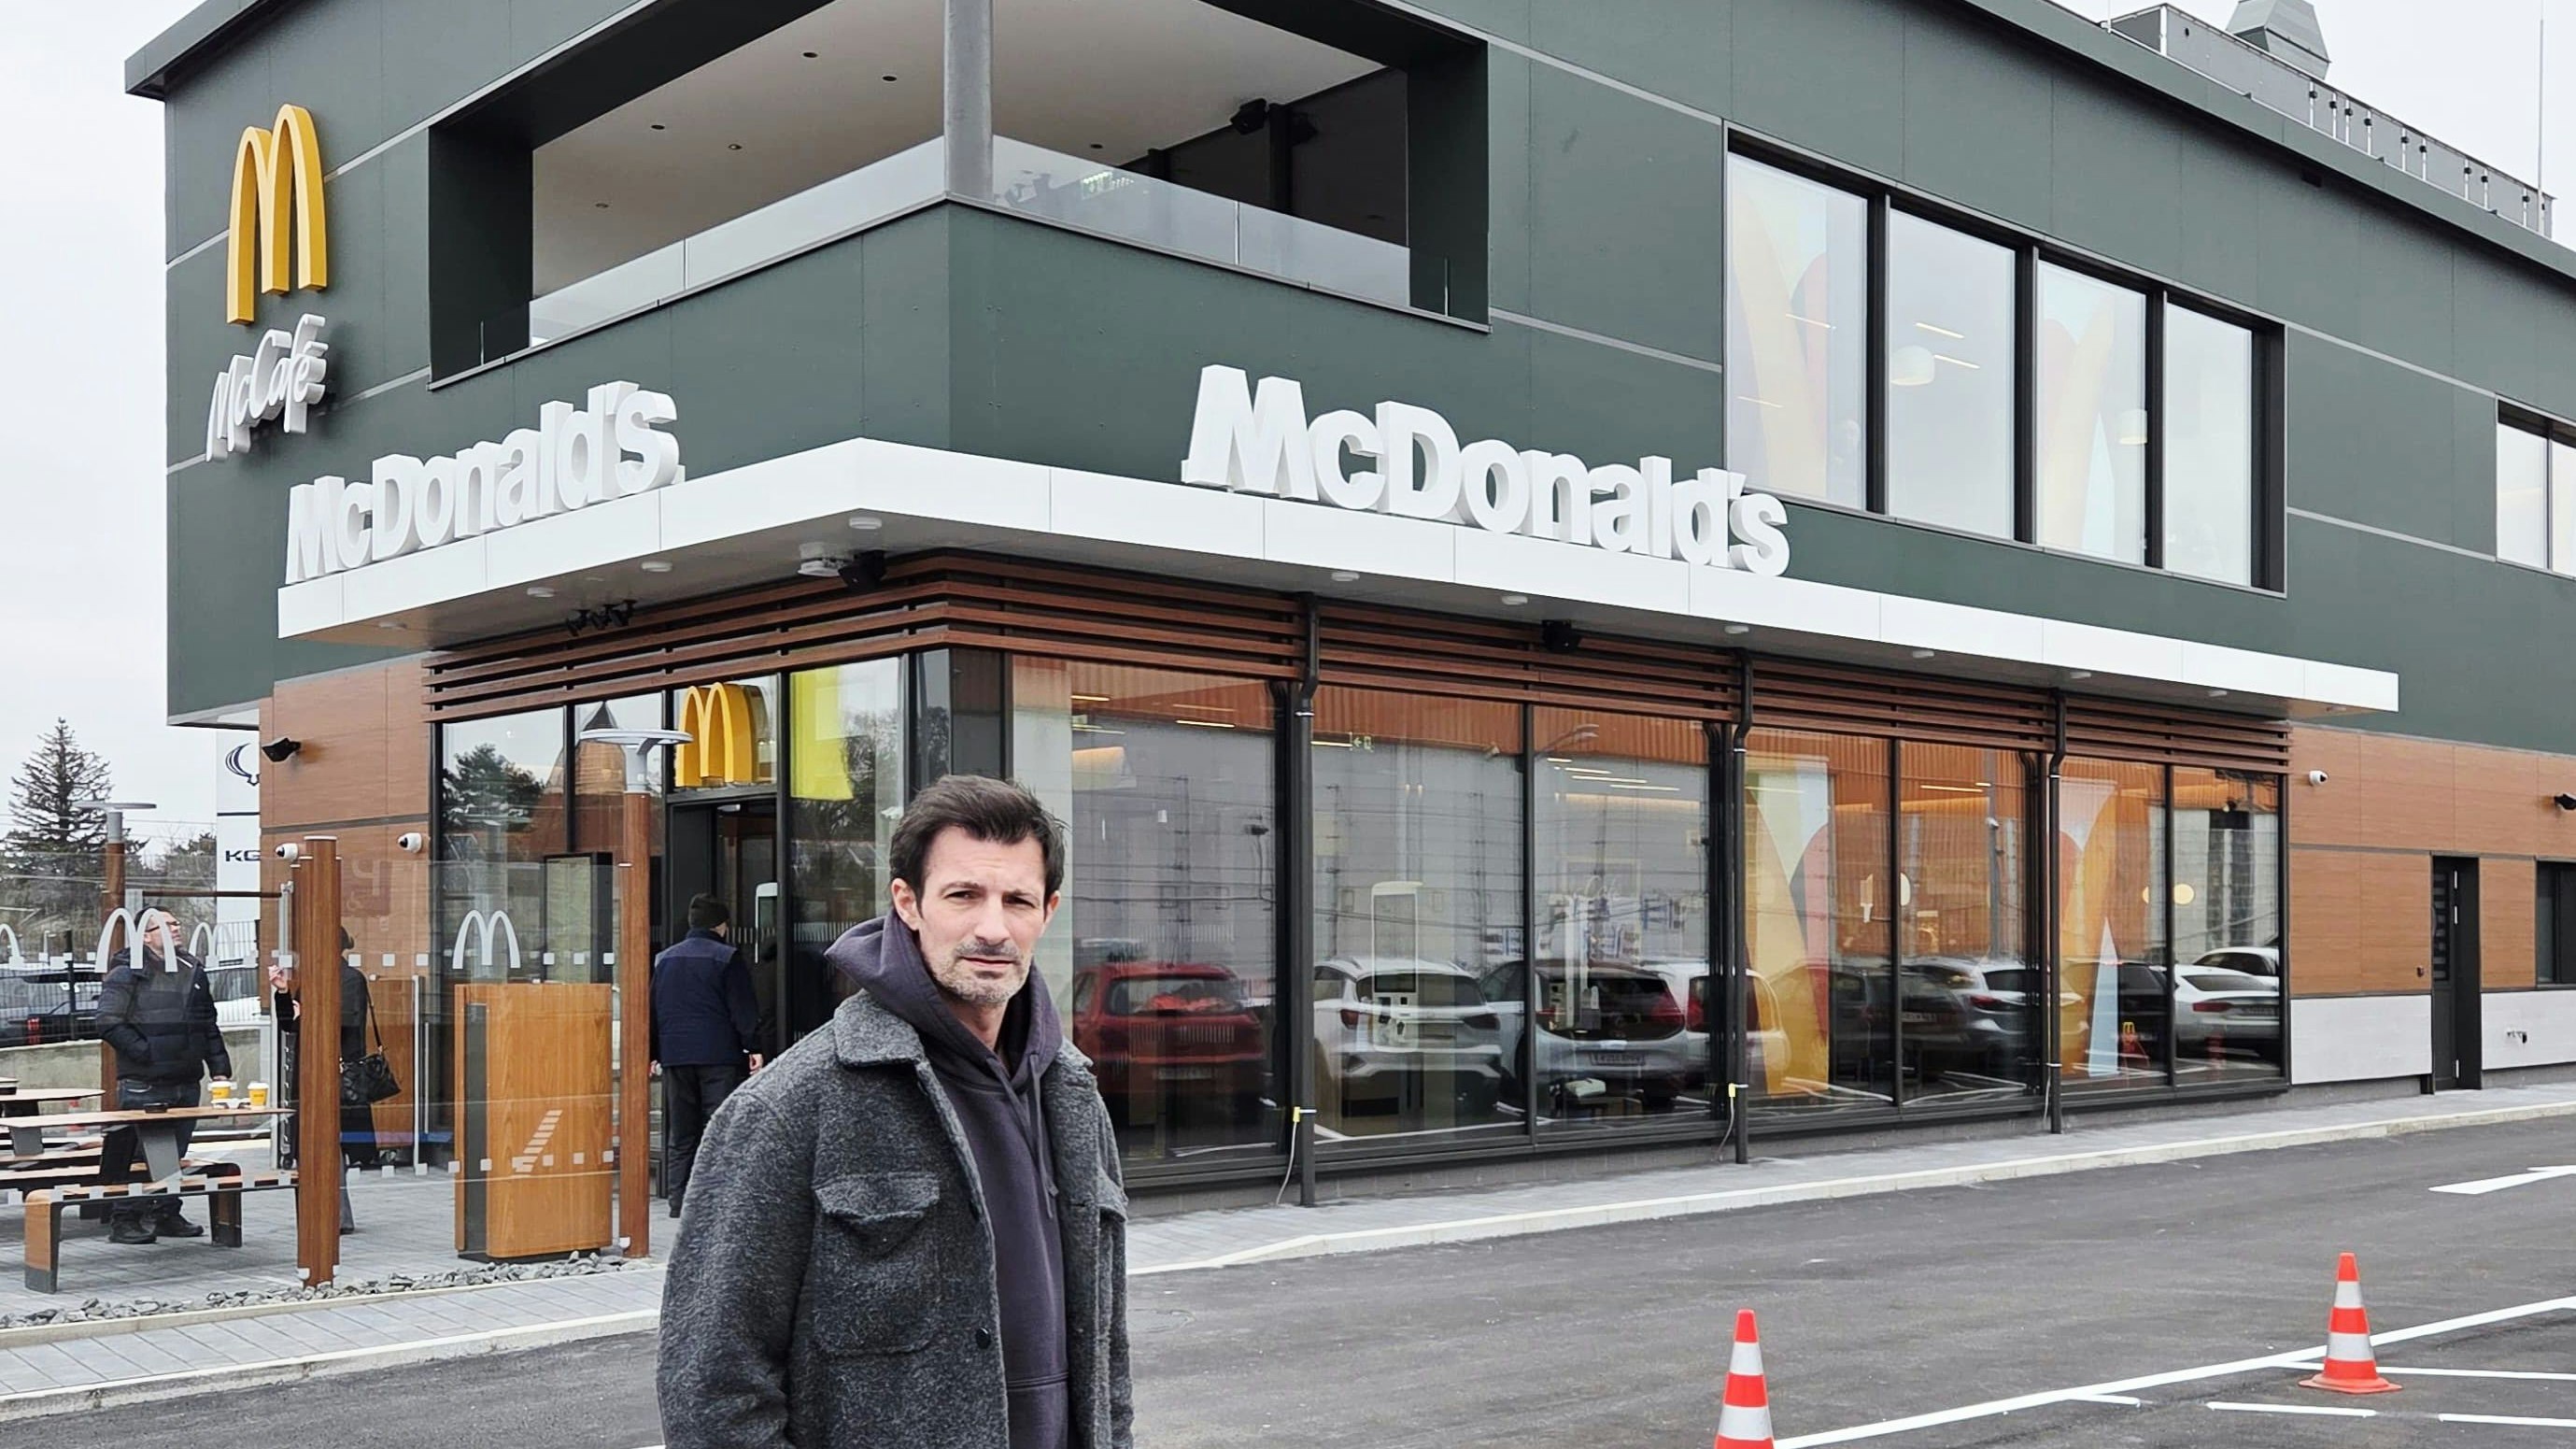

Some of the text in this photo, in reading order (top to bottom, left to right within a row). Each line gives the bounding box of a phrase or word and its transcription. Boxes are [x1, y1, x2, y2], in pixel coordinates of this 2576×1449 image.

[205, 313, 328, 462] McCafé
[1182, 364, 1790, 576] McDonald's
[285, 380, 681, 585] McDonald's
[225, 849, 262, 862] KG
